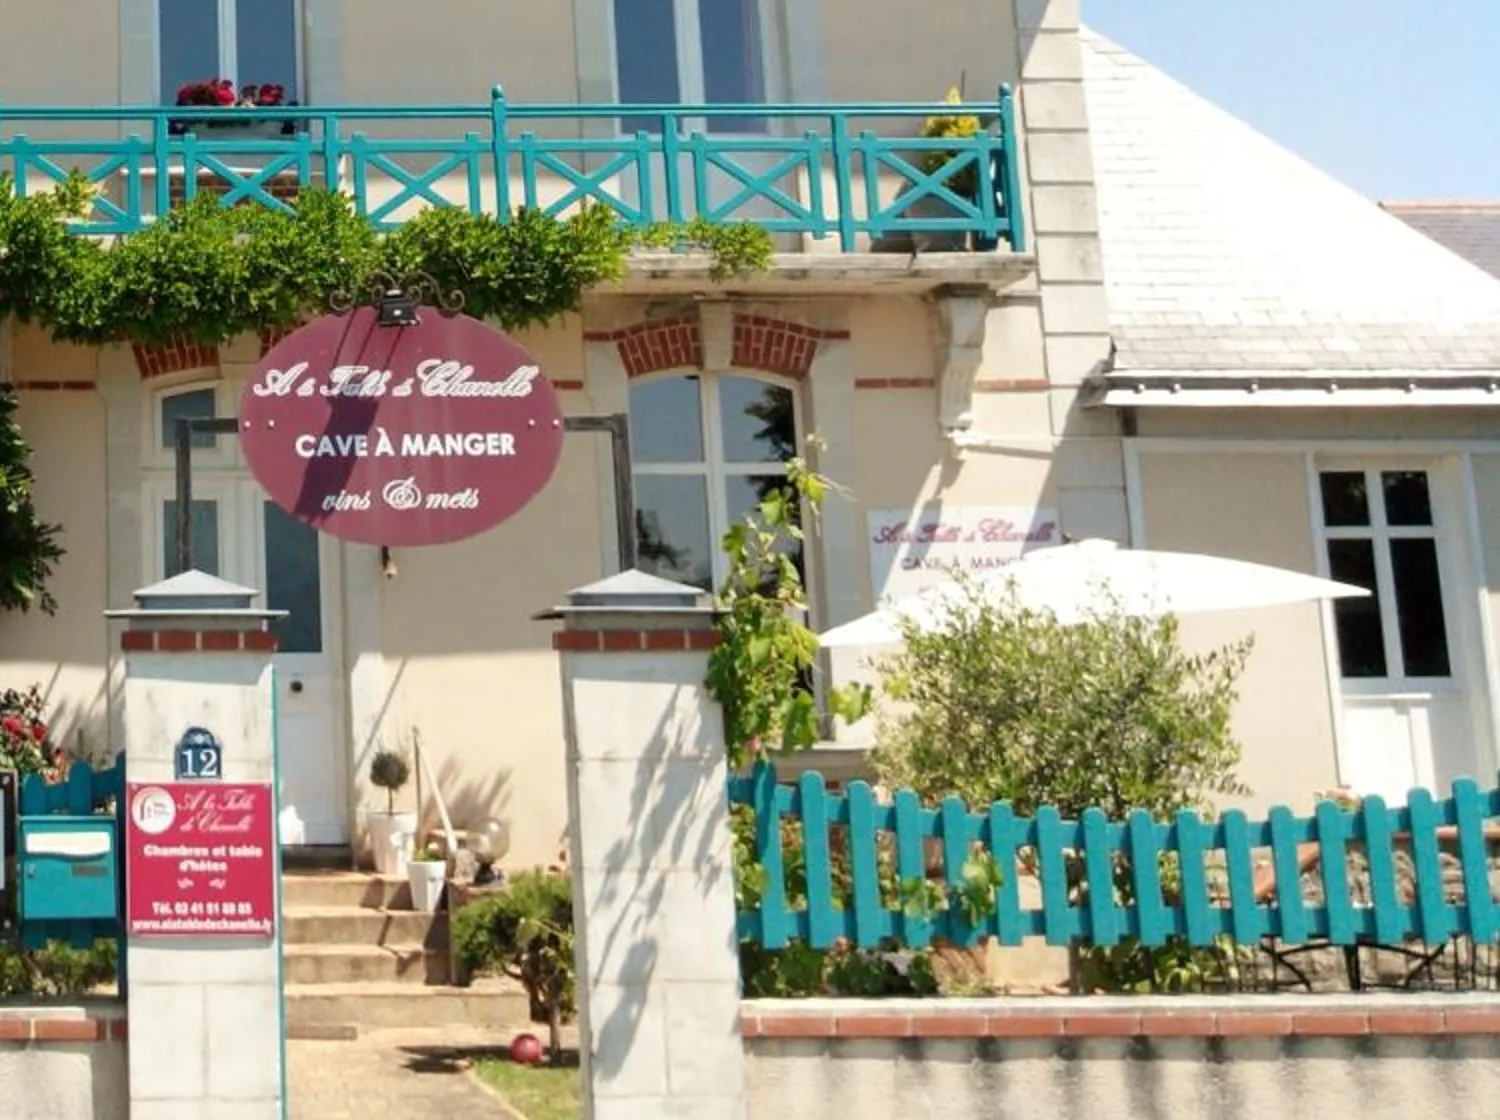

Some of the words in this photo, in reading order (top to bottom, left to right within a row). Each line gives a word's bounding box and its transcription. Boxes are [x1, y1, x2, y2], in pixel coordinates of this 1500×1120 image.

[253, 361, 309, 397] A
[319, 365, 393, 397] Table
[295, 433, 369, 458] CAVE
[374, 427, 395, 457] À
[401, 432, 516, 456] MANGER
[321, 490, 371, 510] vins
[425, 487, 479, 509] mets
[181, 748, 218, 777] 12
[143, 844, 209, 857] Chambres
[211, 845, 227, 857] et
[229, 844, 263, 857] table
